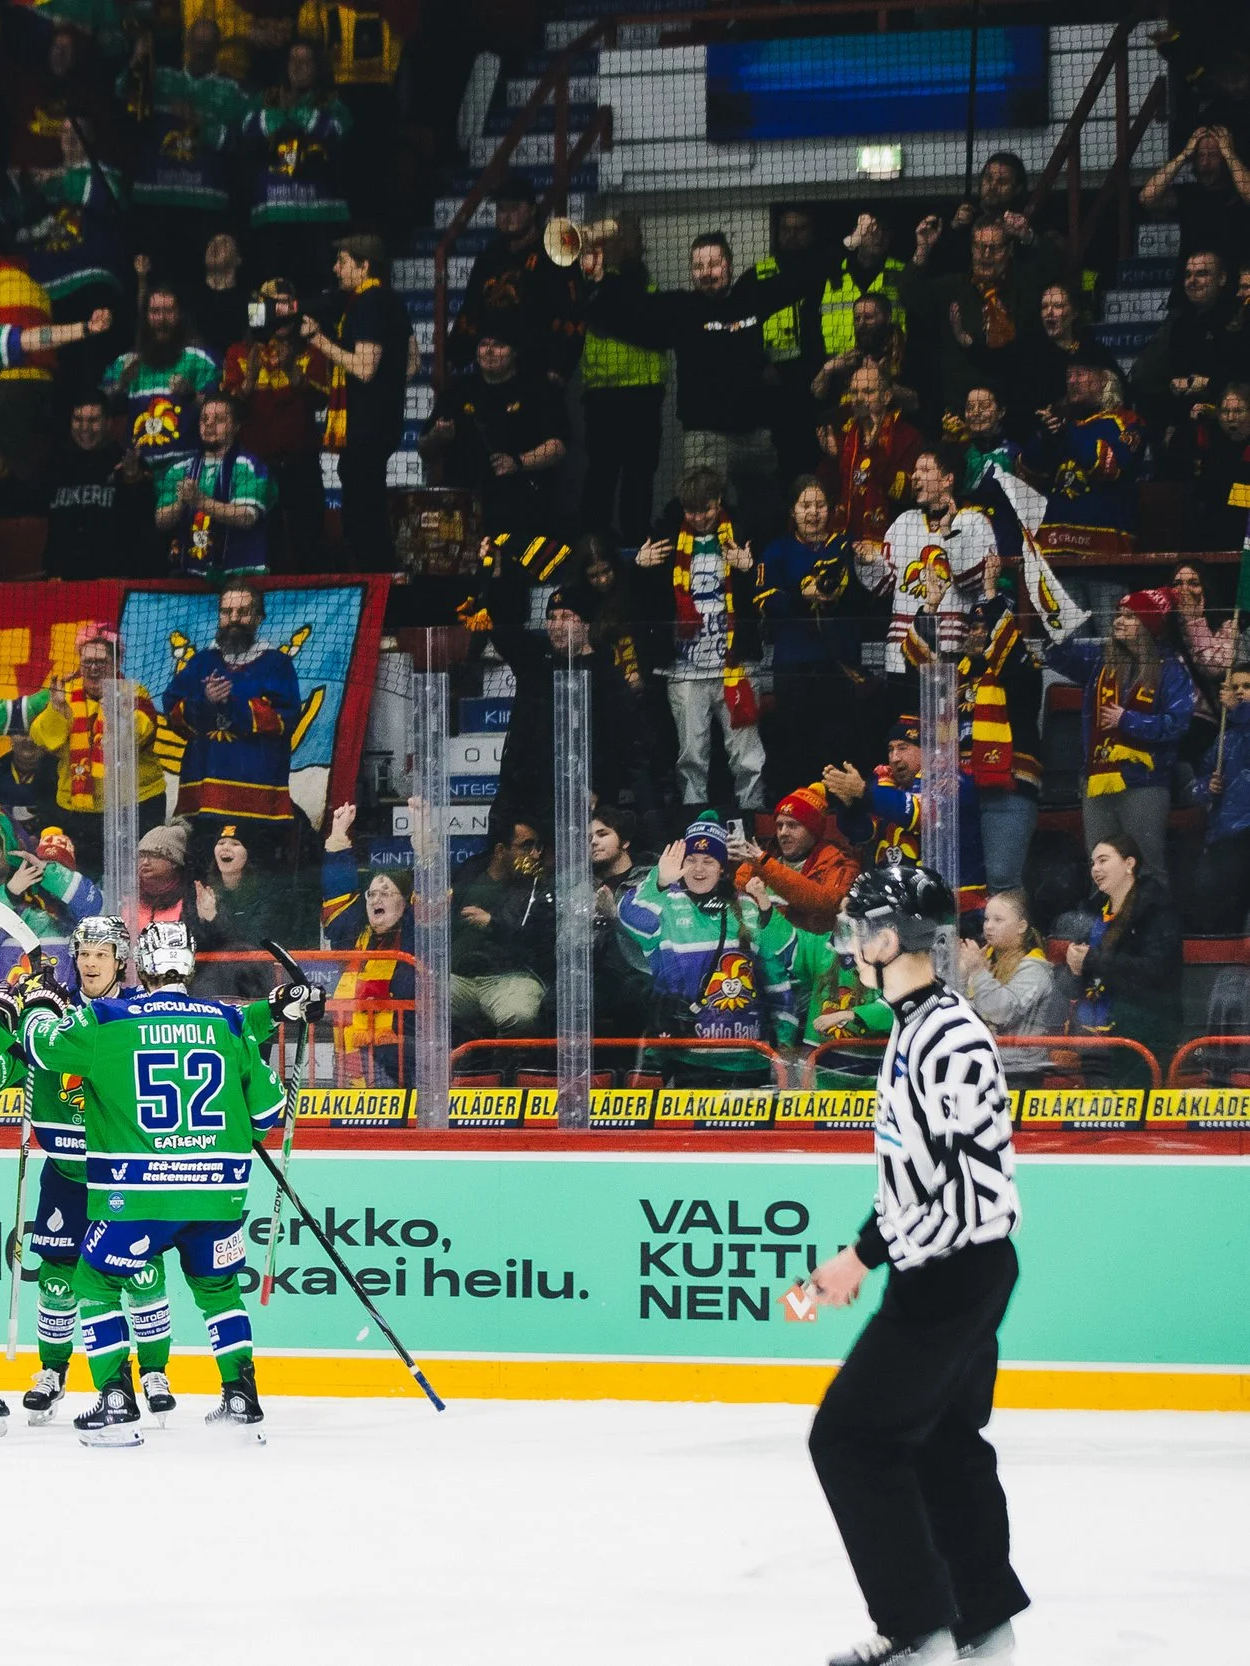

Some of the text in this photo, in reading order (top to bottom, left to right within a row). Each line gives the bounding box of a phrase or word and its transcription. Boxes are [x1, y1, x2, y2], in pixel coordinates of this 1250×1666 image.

[143, 1001, 223, 1016] CIRCULATION
[137, 1024, 216, 1045] TUOMOLA
[133, 1048, 226, 1133] 52
[299, 1090, 400, 1115] BLÅKLÄDER
[661, 1090, 767, 1118] BLÅKLÄDER
[782, 1090, 875, 1118] BLÅKLÄDE
[1028, 1091, 1138, 1117] BLÅKLÄDER
[1153, 1091, 1250, 1117] BLÅKLÄDE
[153, 1134, 217, 1150] EAT&ENJOY
[143, 1172, 225, 1184] Rakennus Oy
[148, 1161, 224, 1171] Itä-Vantaan
[242, 1207, 452, 1253] erkko,
[639, 1199, 810, 1236] VALO
[32, 1233, 75, 1247] INFUEL
[105, 1253, 147, 1268] INFUEL
[240, 1255, 590, 1301] oka ei heilu.
[640, 1284, 770, 1321] NEN
